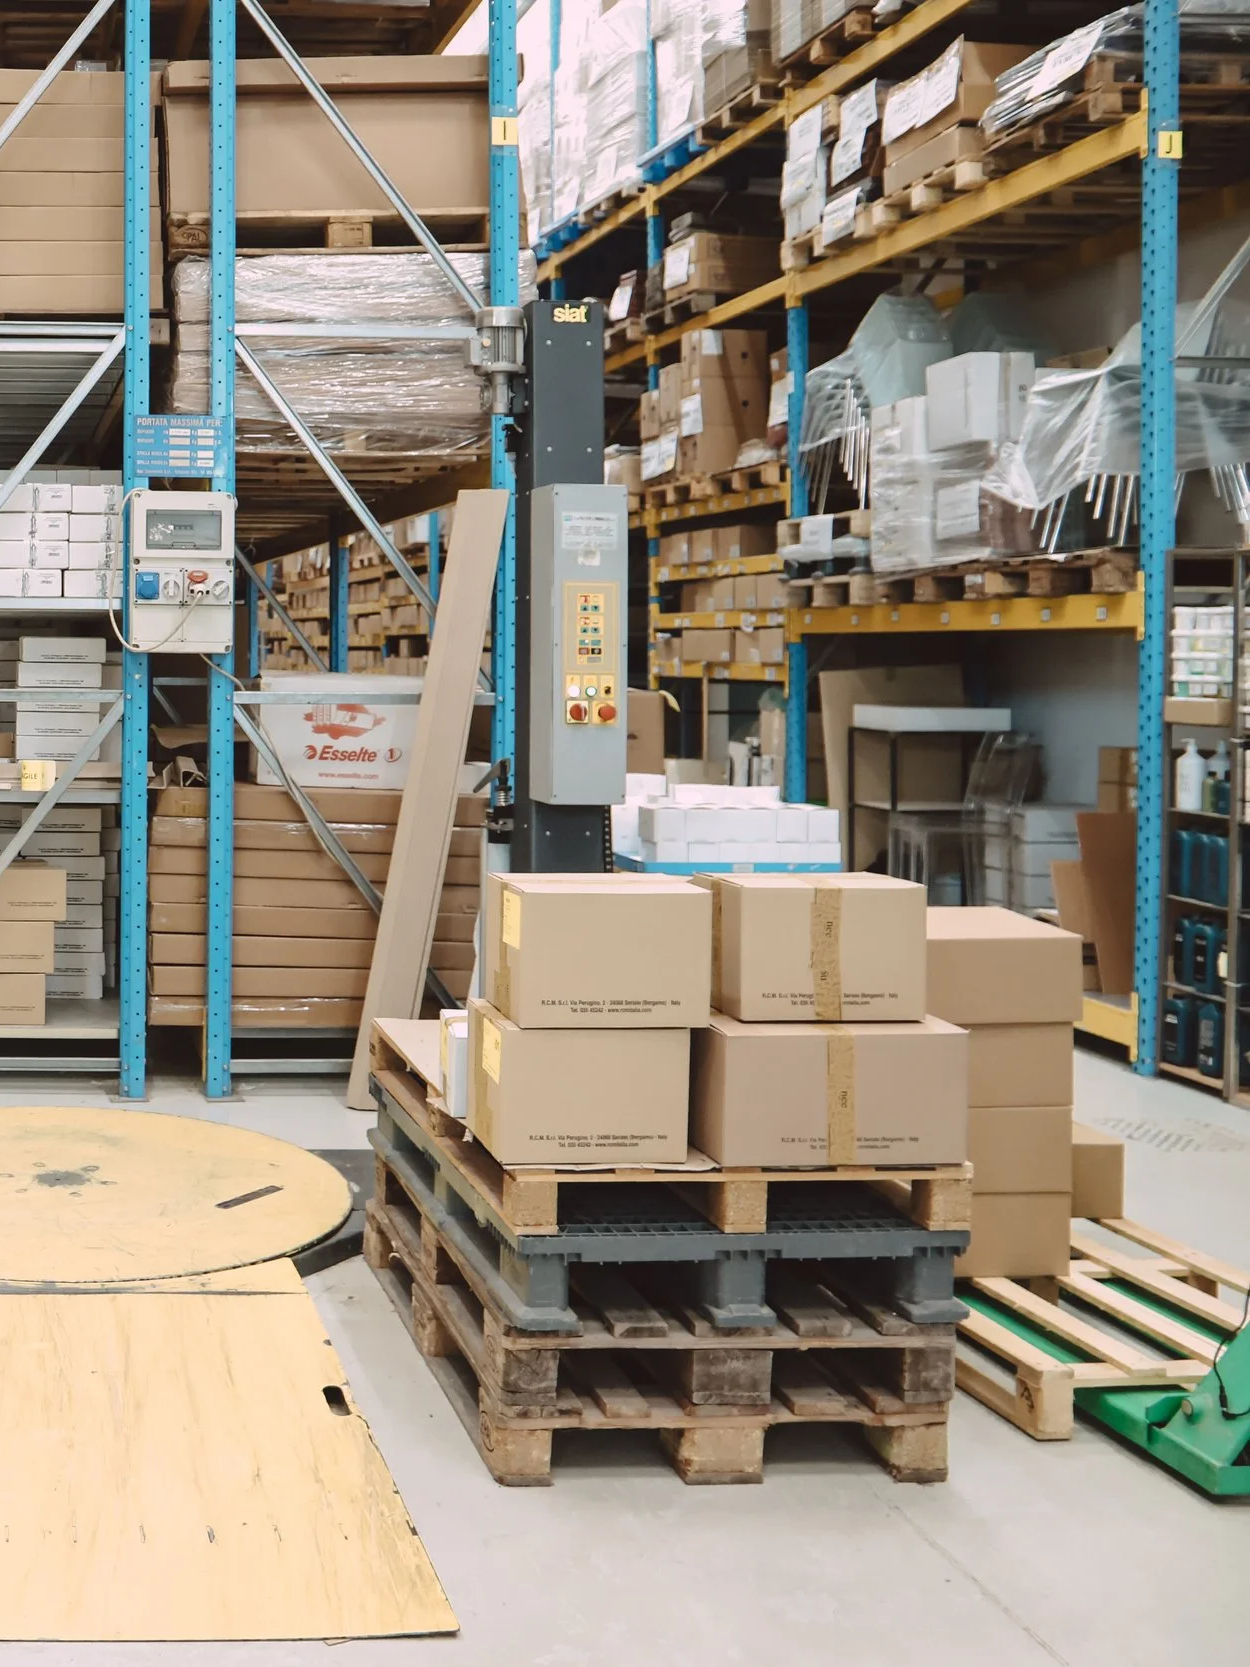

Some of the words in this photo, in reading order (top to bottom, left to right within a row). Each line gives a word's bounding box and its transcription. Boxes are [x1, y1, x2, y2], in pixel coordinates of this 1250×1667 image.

[1166, 135, 1172, 154] J
[553, 304, 589, 323] siat
[137, 417, 168, 426] PORTATA
[170, 418, 204, 427] MASSIMA
[318, 745, 377, 762] Esselte
